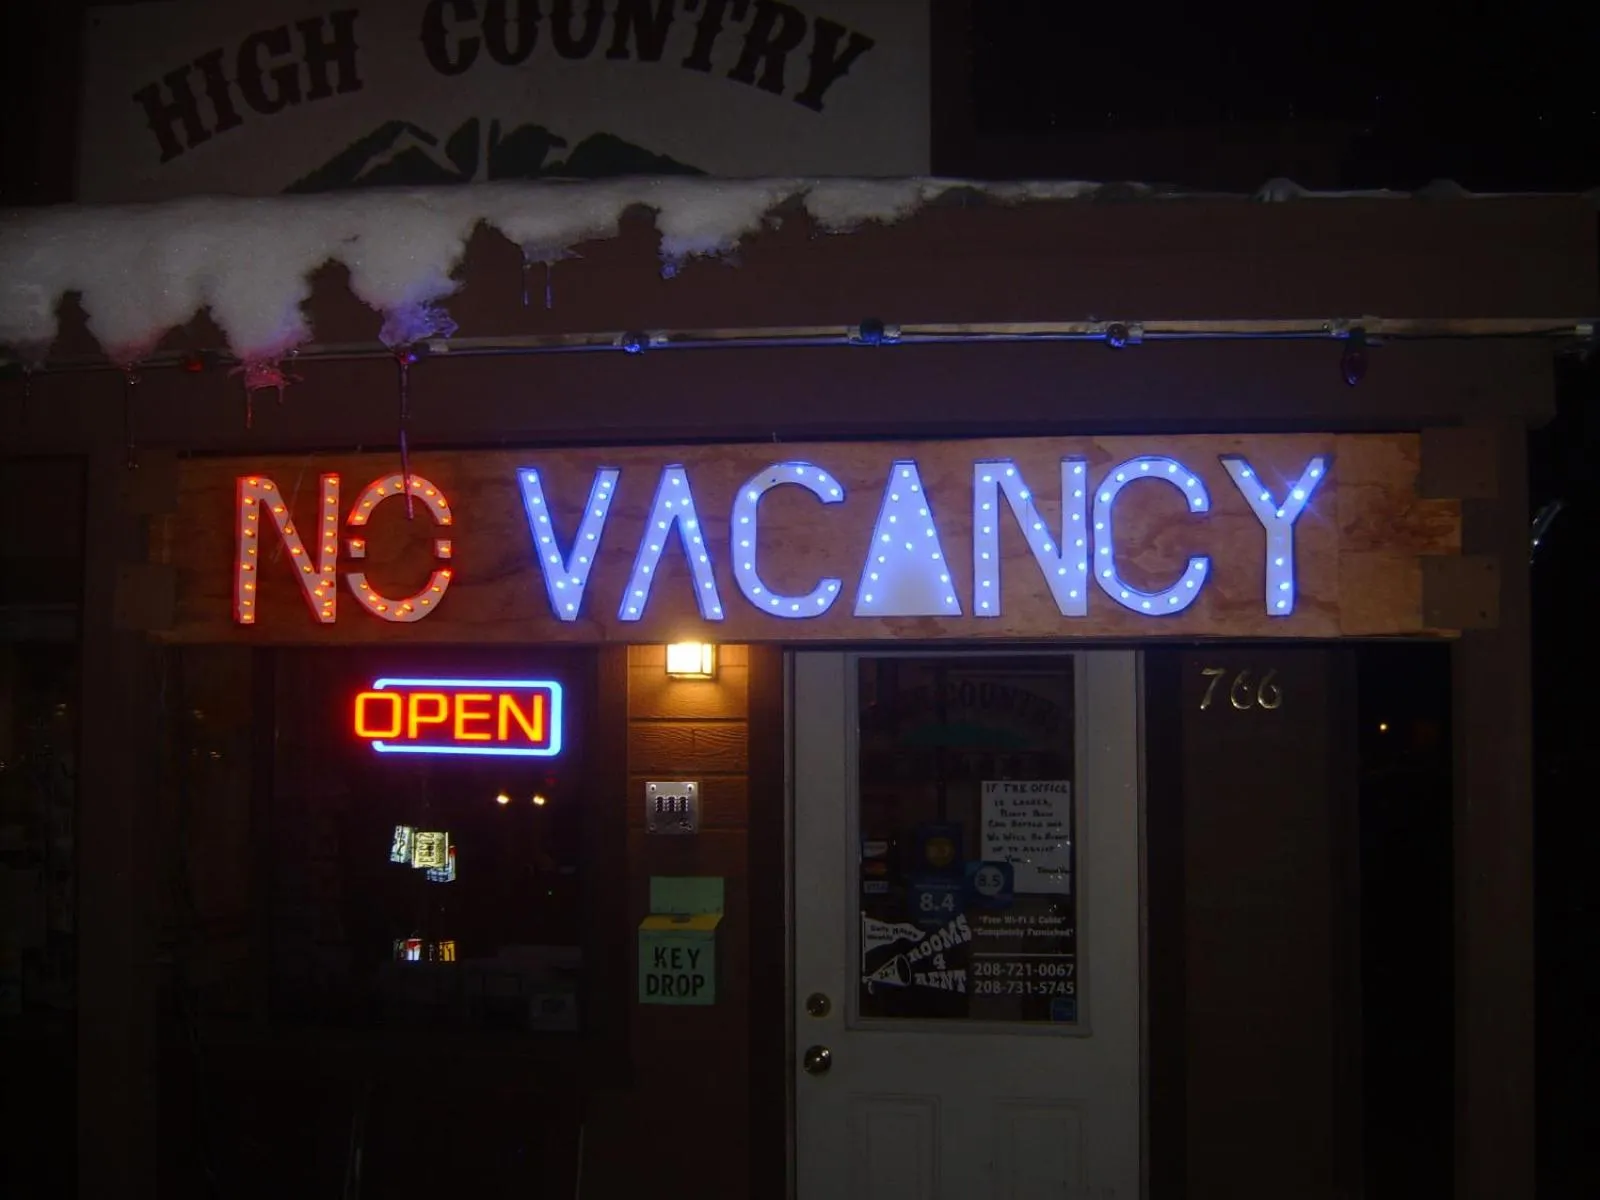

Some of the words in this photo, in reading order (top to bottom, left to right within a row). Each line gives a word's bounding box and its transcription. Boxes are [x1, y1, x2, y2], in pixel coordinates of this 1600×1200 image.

[132, 8, 363, 163] HIGH
[419, 0, 875, 112] COUNTRY
[233, 473, 454, 624] NO
[516, 455, 1331, 622] VACANCY
[1199, 667, 1284, 711] 766
[353, 690, 545, 742] OPEN
[986, 783, 998, 793] IF
[1003, 783, 1028, 793] THE
[1031, 783, 1068, 794] OFFICE
[978, 873, 1000, 888] 8.5
[919, 892, 955, 912] 8.4
[908, 913, 972, 963] ROOMS
[654, 946, 700, 970] KEY
[932, 953, 947, 970] 4
[974, 963, 1074, 977] 208-721-0067
[646, 973, 704, 997] DROP
[914, 968, 968, 994] RENT
[974, 980, 1074, 995] 208-731-5745
